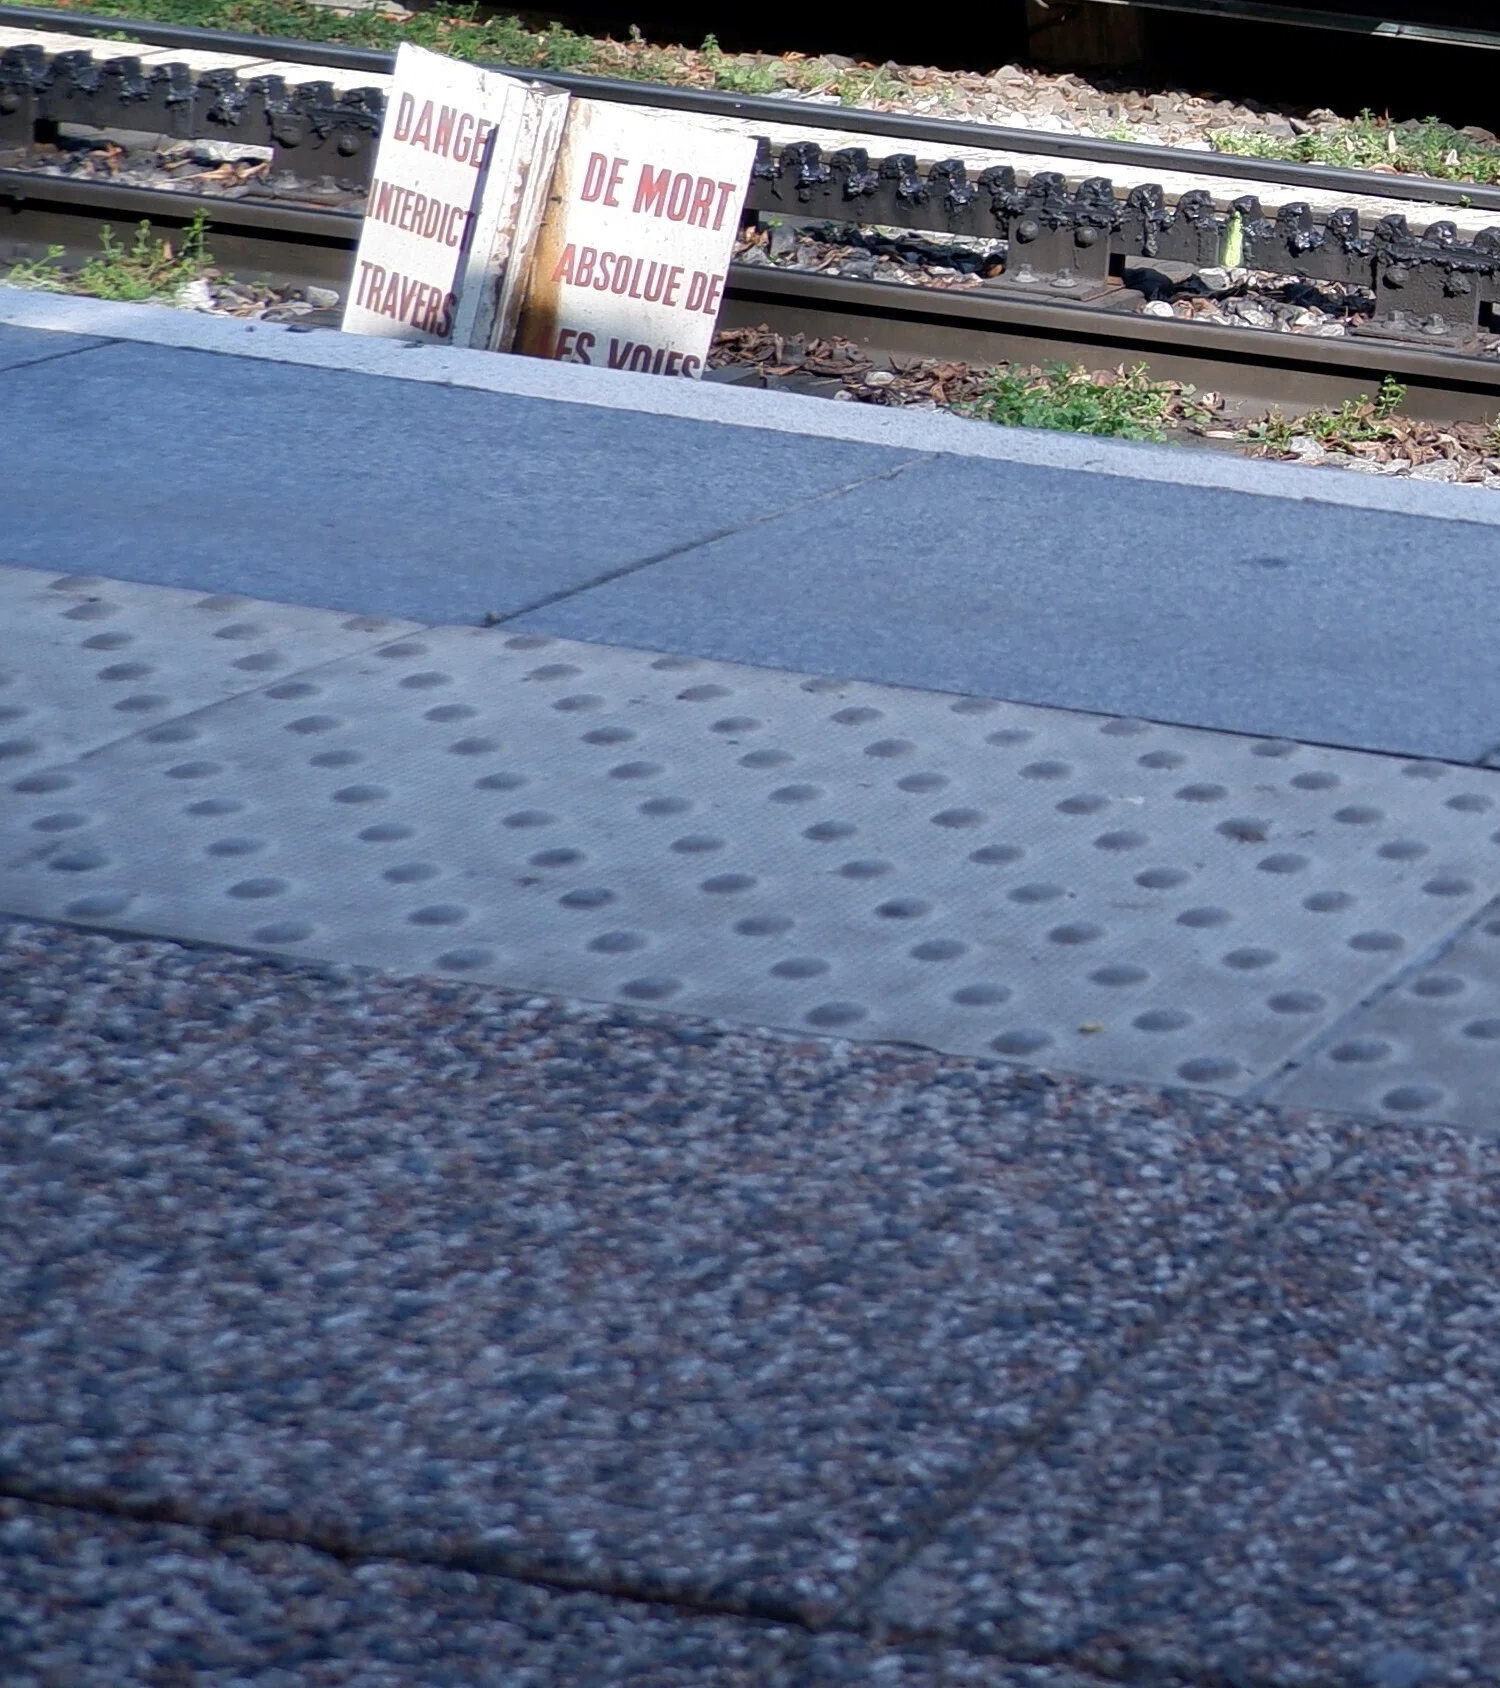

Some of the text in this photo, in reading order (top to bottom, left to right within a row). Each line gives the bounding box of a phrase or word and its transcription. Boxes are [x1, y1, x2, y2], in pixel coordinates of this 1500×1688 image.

[393, 92, 737, 232] DANGE DE MORT
[356, 259, 458, 339] TRAVERS
[551, 242, 685, 307] ABSOLUE
[685, 270, 724, 316] DE
